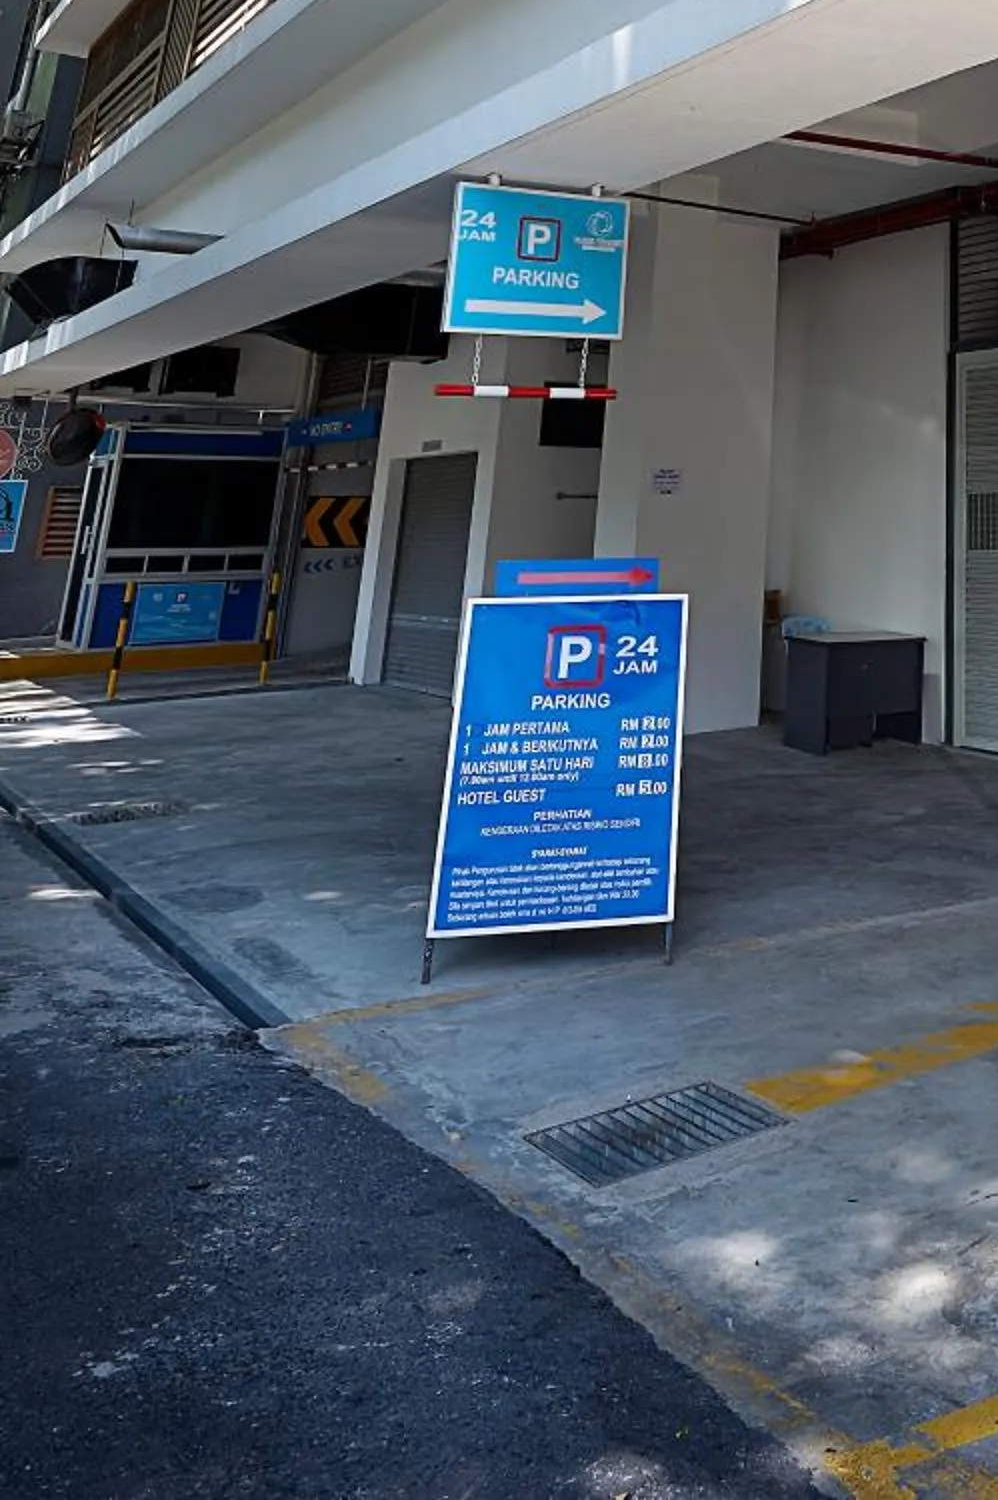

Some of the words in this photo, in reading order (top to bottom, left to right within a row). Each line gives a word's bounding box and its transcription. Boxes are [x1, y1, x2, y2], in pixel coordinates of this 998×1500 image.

[461, 210, 497, 229] 24
[458, 230, 496, 243] JAM
[527, 223, 551, 256] P
[492, 267, 580, 289] PARKING
[615, 635, 659, 657] 24
[557, 635, 593, 679] P
[612, 659, 658, 675] JAM
[531, 692, 611, 711] PARKING
[465, 724, 472, 737] 1
[483, 723, 510, 737] JAM
[511, 721, 570, 735] PERTAMA
[621, 717, 639, 731] RM
[463, 743, 470, 756] 1
[481, 741, 508, 755] JAM
[509, 741, 519, 755] &
[521, 737, 599, 754] BERIKUTNYA
[619, 736, 638, 750] RM
[460, 759, 527, 775] MAKSIMUM
[530, 757, 563, 772] SATU
[565, 755, 595, 771] HARI
[618, 755, 637, 768] RM
[457, 789, 501, 805] HOTEL
[503, 787, 547, 804] GUEST
[615, 783, 635, 797] RM
